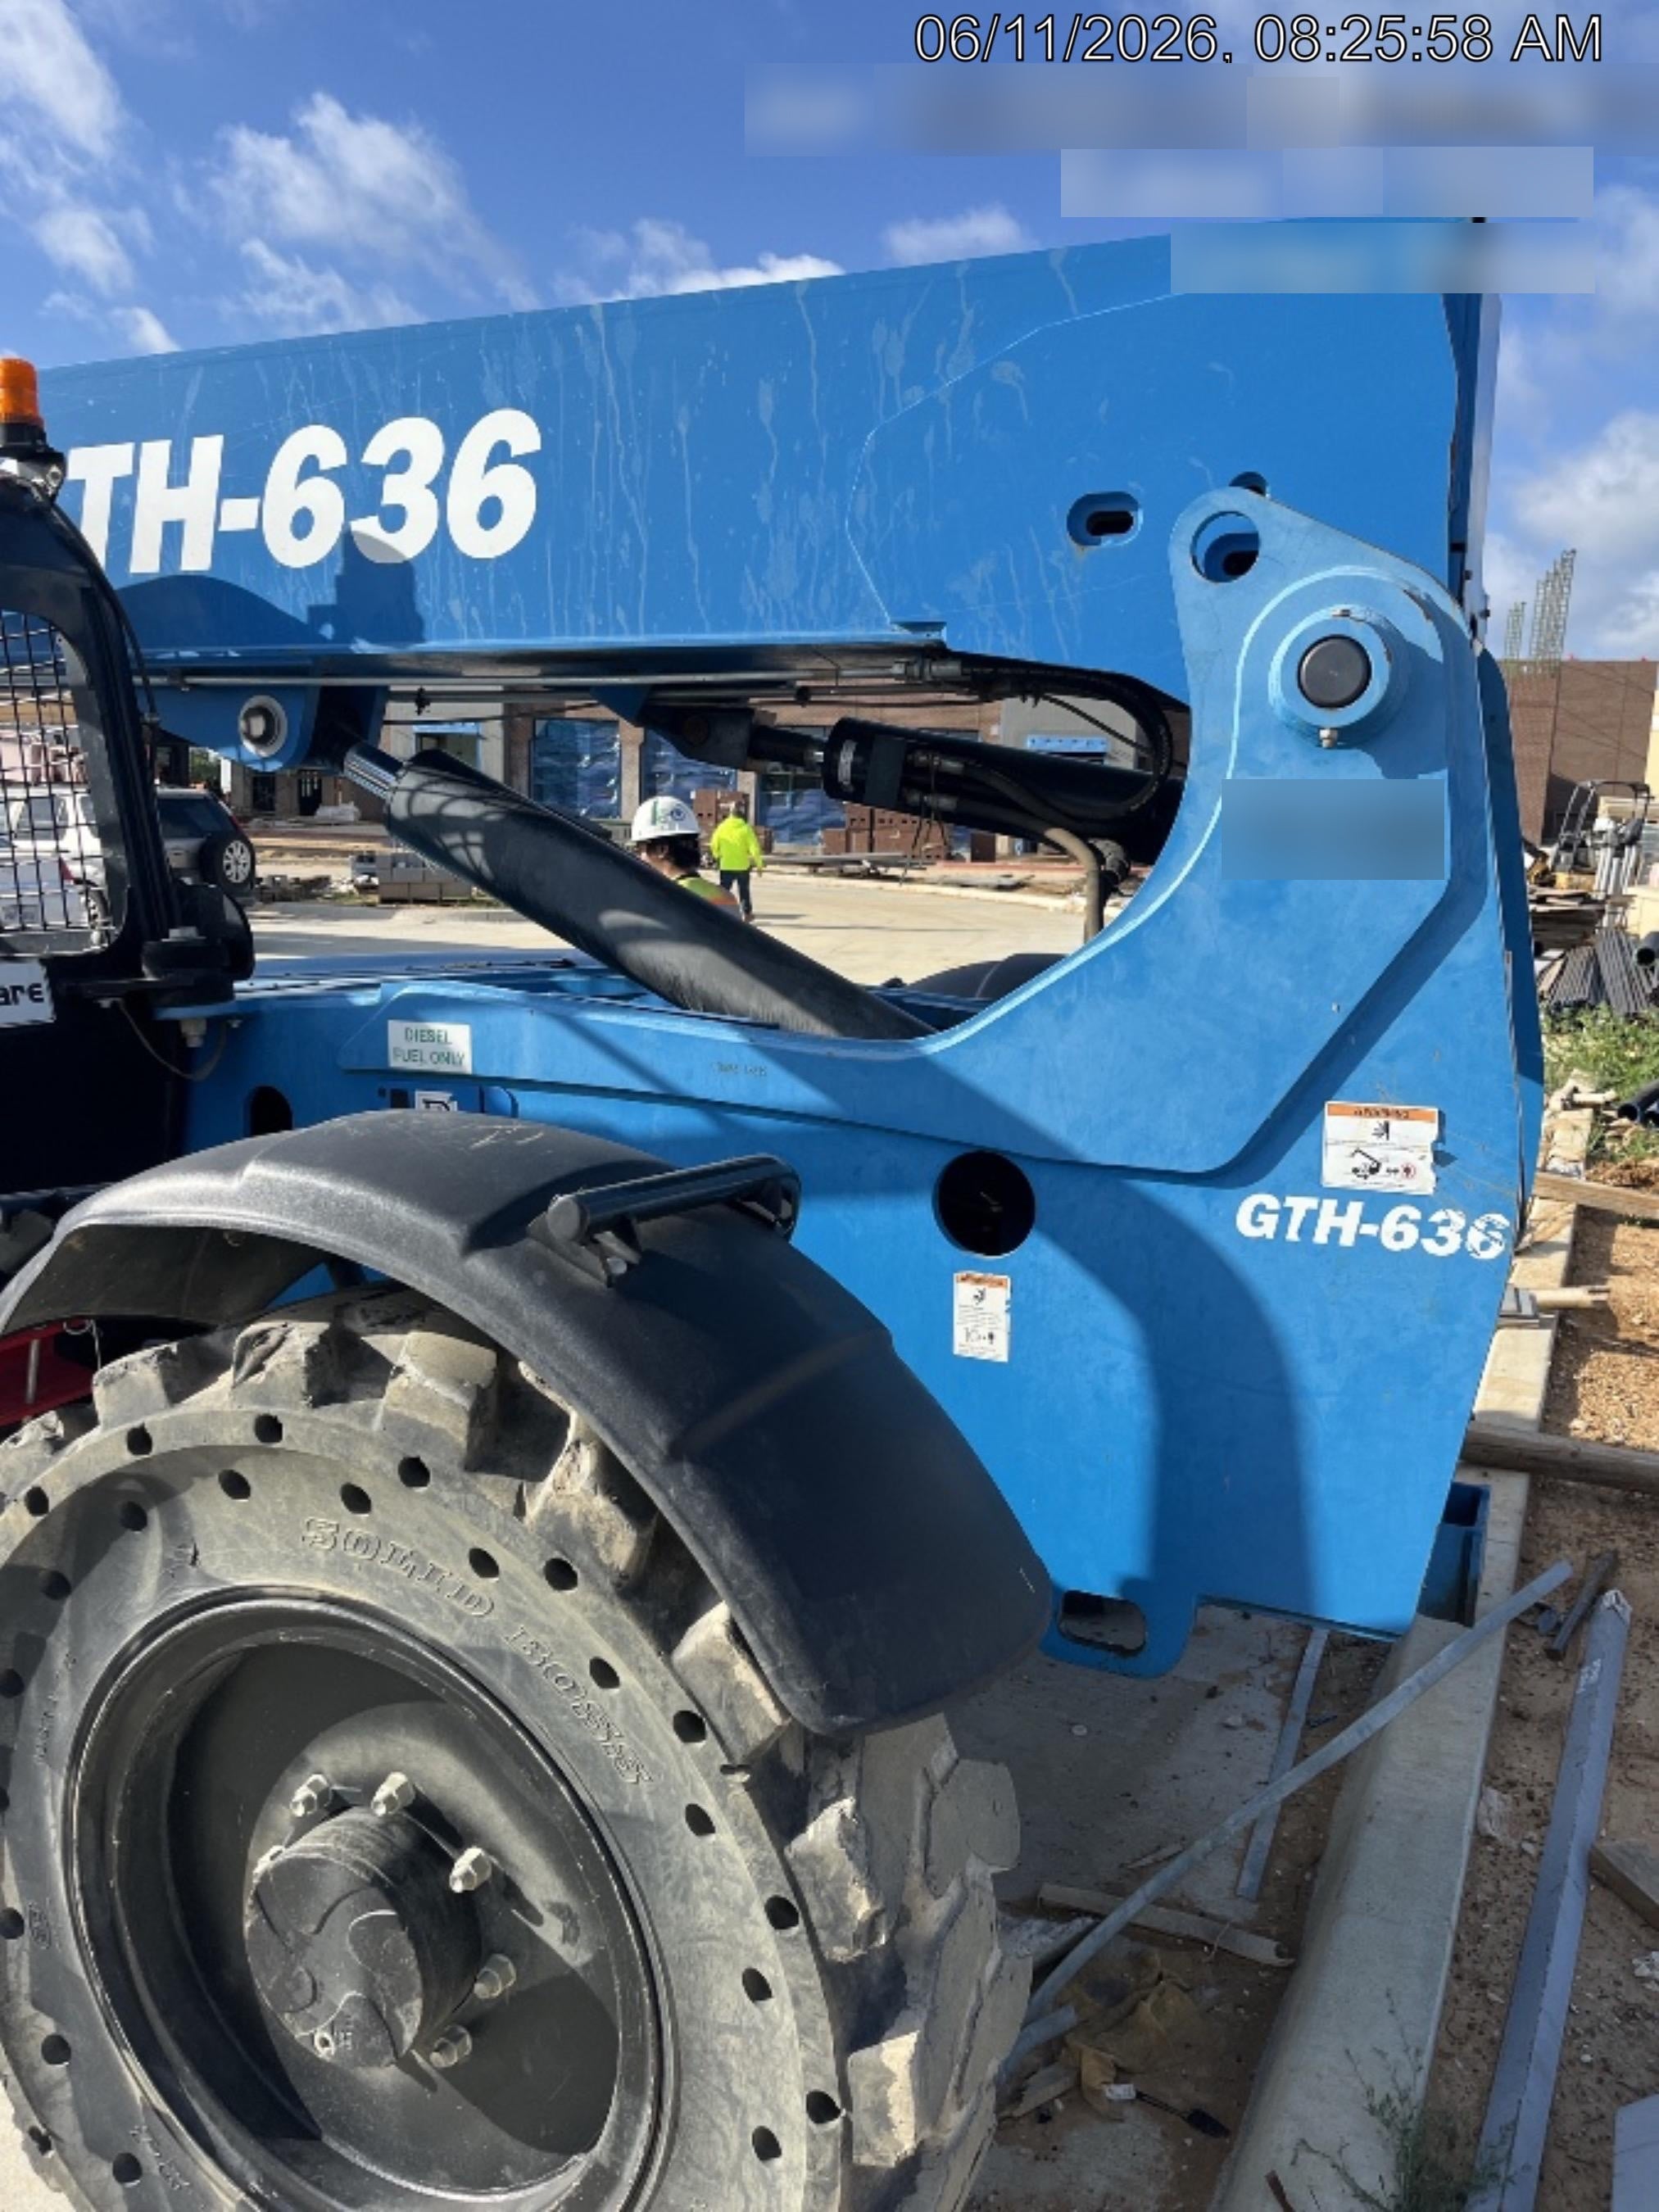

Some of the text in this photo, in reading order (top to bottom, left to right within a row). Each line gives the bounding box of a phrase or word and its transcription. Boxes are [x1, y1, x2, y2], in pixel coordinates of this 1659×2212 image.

[392, 1046, 465, 1066] FUEL ONLY
[406, 1027, 451, 1045] DIESEL
[1235, 1193, 1511, 1260] GTH-636
[301, 1516, 495, 1617] SOLID
